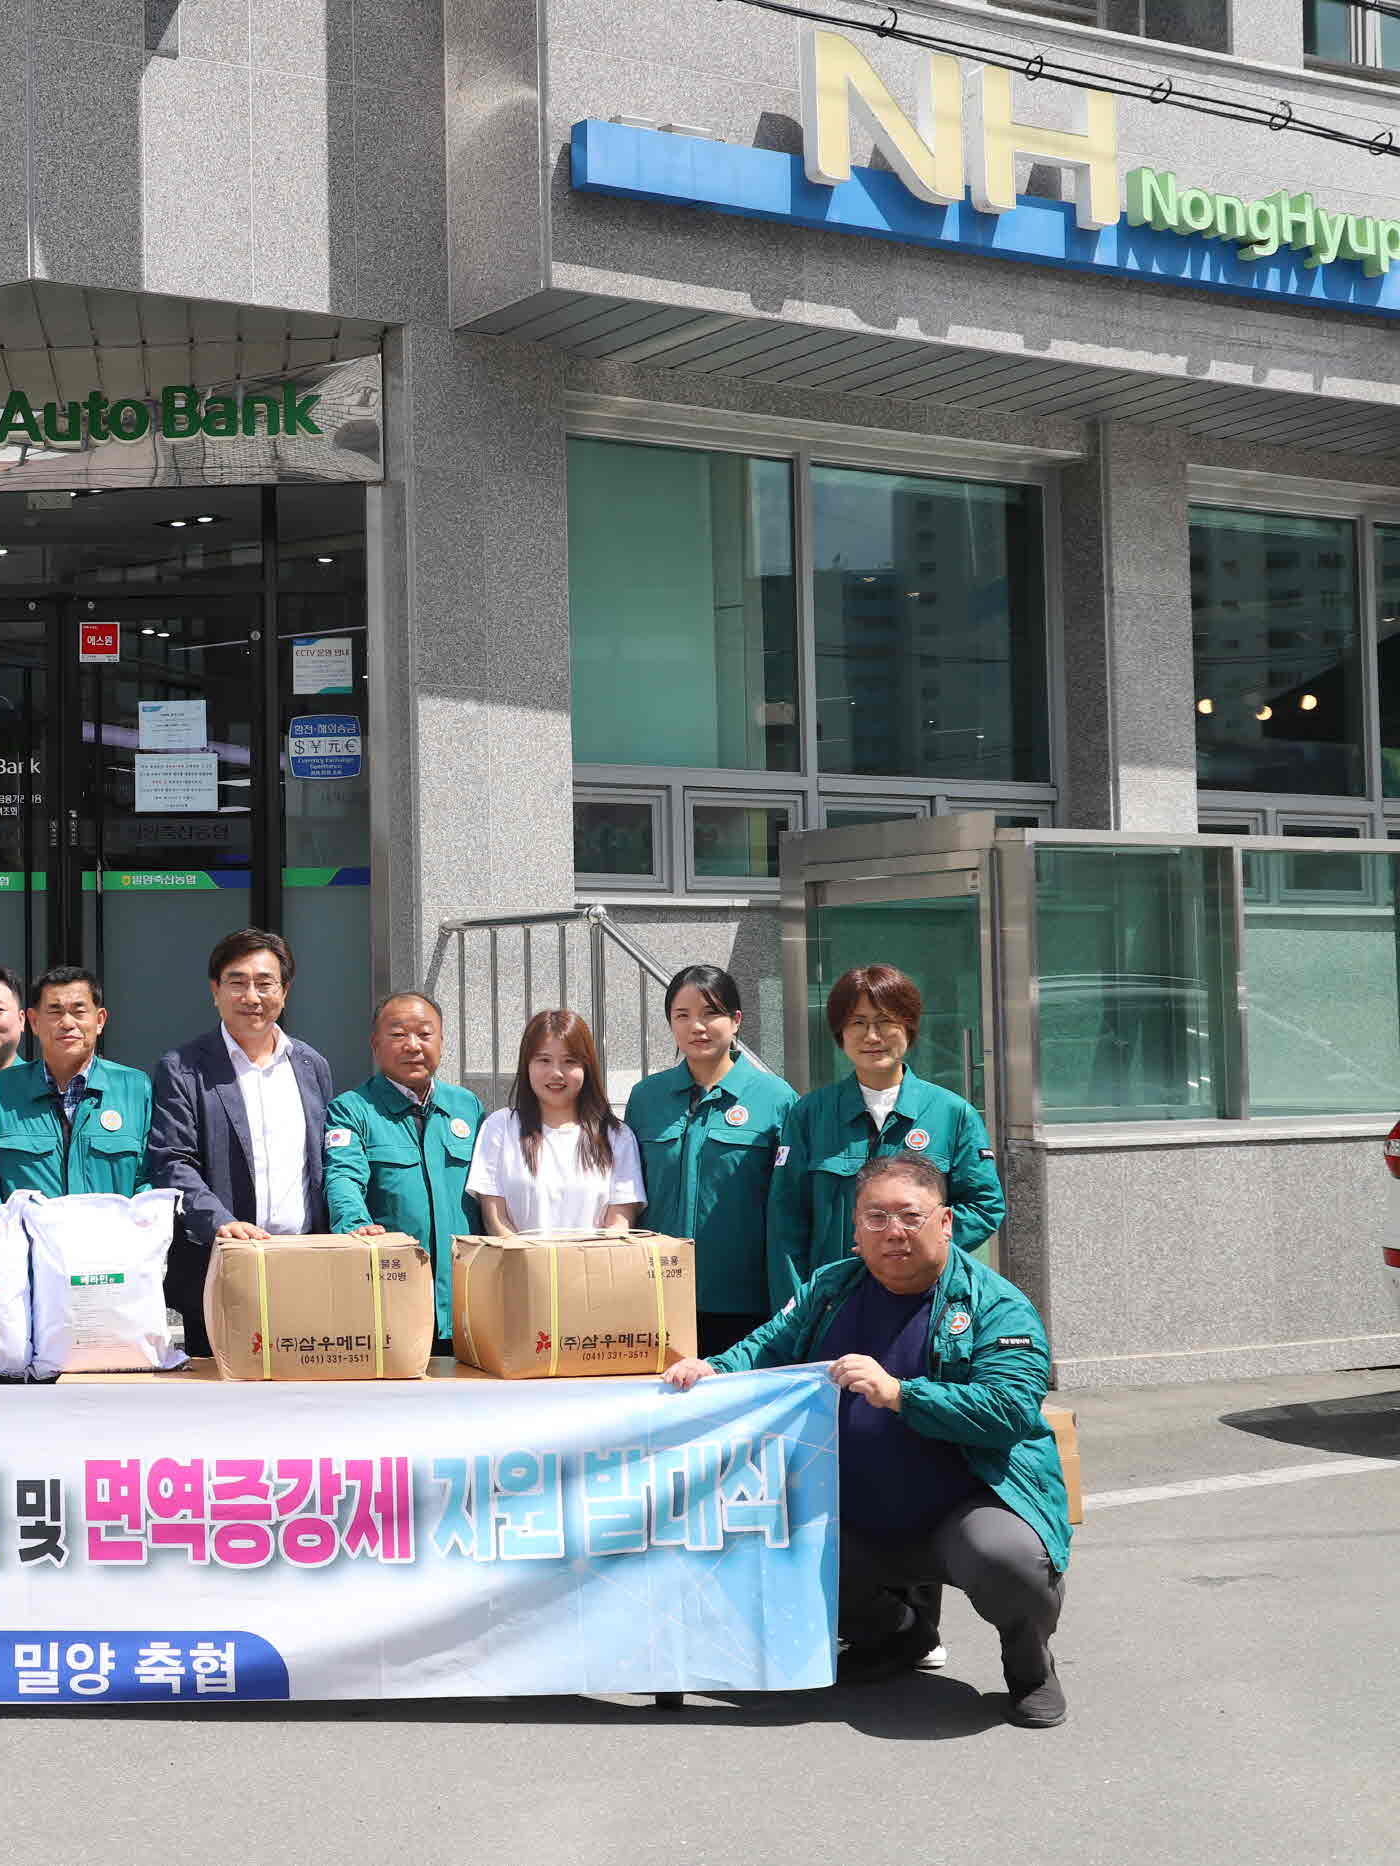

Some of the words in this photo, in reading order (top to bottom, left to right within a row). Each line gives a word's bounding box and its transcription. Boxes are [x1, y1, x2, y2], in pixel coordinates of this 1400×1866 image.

[806, 30, 1119, 229] NH
[1126, 166, 1400, 279] NongHyup
[160, 383, 324, 443] Bank
[87, 635, 113, 646] 에스원
[294, 739, 305, 755] $
[300, 1355, 324, 1364] (041)
[327, 1354, 369, 1363] 331-3511
[582, 1352, 605, 1361] (041)
[607, 1351, 649, 1360] 331-3511
[13, 1476, 67, 1567] 및
[84, 1456, 414, 1568] 면역증강제
[432, 1449, 566, 1561] 지원
[582, 1434, 791, 1556] 발대식
[14, 1641, 116, 1697] 밀양
[134, 1640, 237, 1697] 축협
